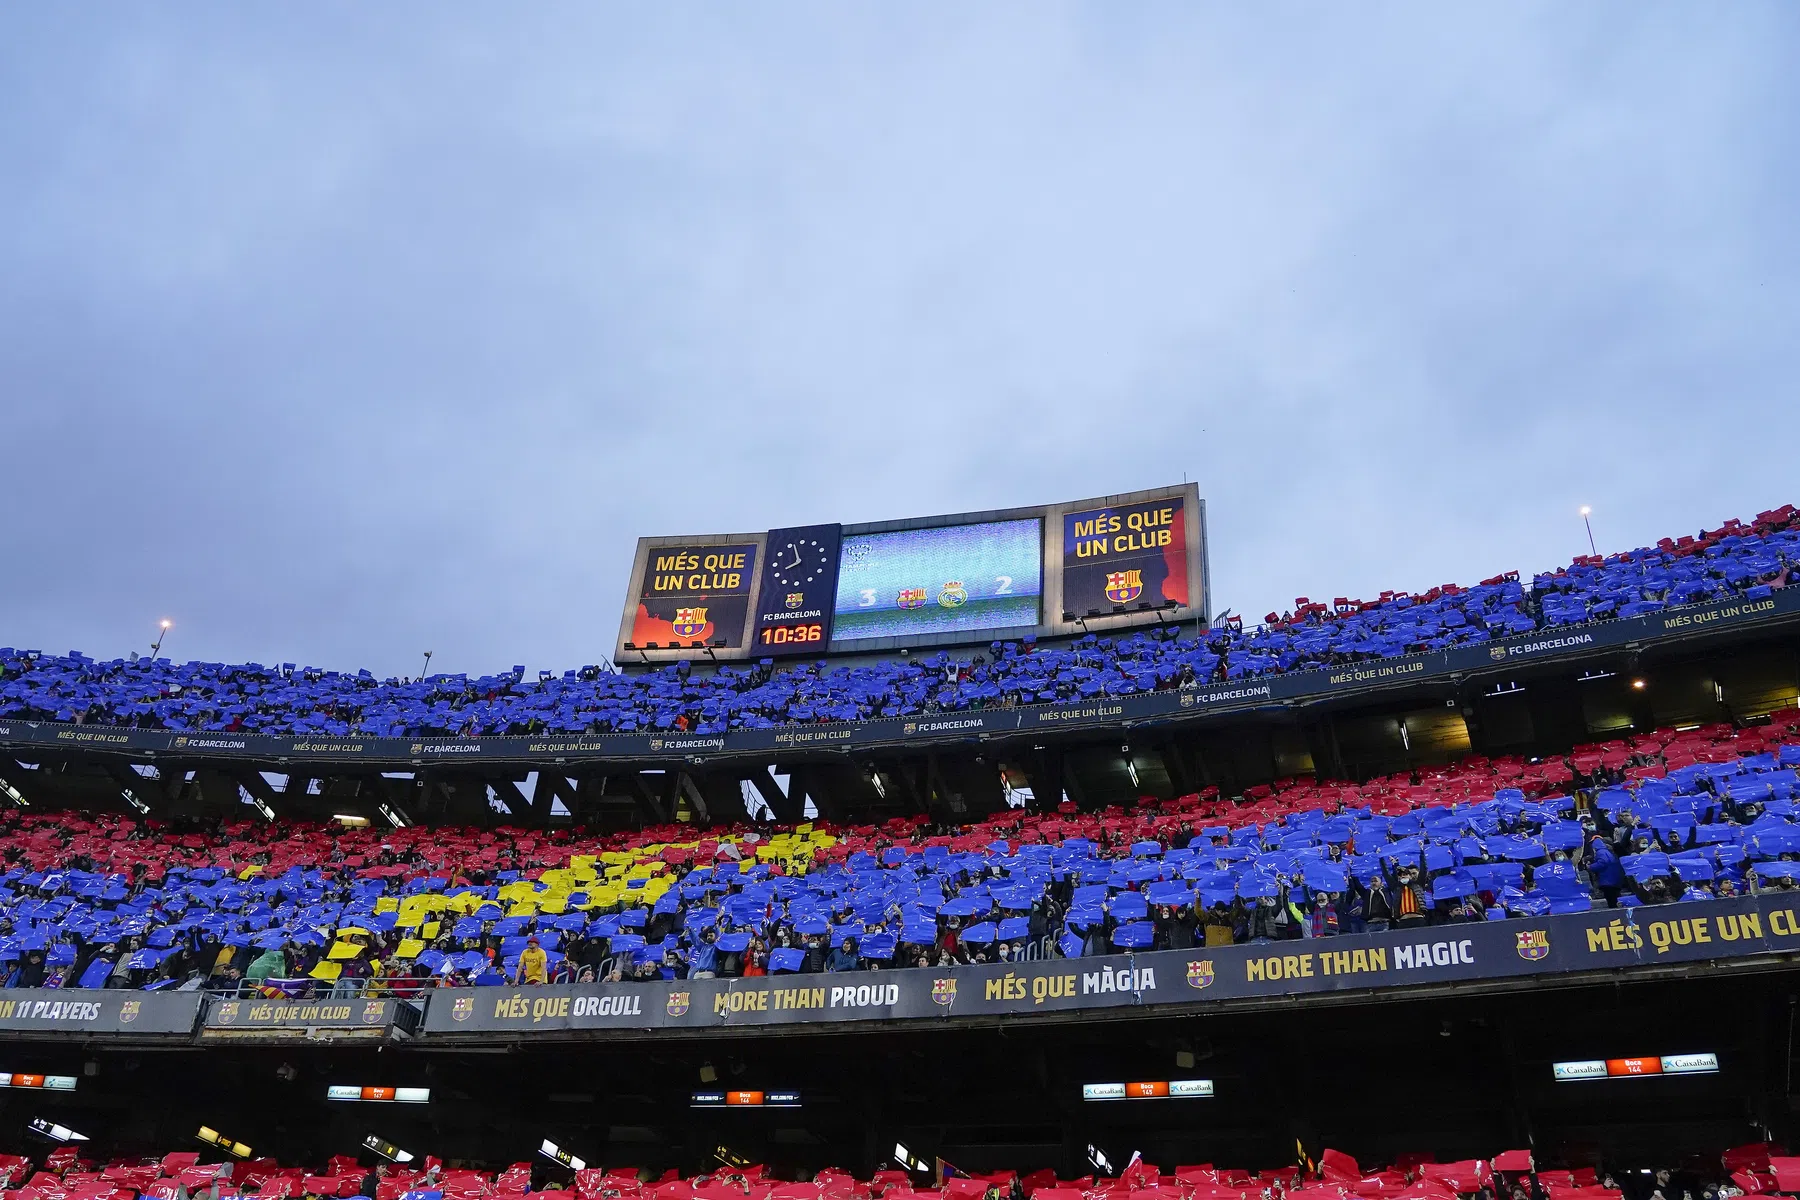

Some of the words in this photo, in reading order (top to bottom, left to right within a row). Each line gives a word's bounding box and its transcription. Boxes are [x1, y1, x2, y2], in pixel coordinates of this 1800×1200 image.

[1074, 511, 1121, 538] MÉS
[1128, 507, 1173, 532] QUE
[1076, 538, 1107, 558] UN
[1114, 529, 1172, 553] CLUB
[655, 552, 700, 571] MÉS
[704, 552, 746, 573] QUE
[654, 575, 683, 591] UN
[687, 573, 741, 590] CLUB
[995, 576, 1012, 594] 2
[859, 588, 877, 607] 3
[763, 613, 774, 621] FC
[774, 610, 821, 620] BARCELONA
[1664, 614, 1691, 629] MÉS
[1693, 610, 1720, 625] QUE
[1721, 606, 1740, 618] UN
[1742, 600, 1775, 614] CLUB
[761, 625, 822, 645] 10:36
[1508, 645, 1523, 656] FC
[1524, 633, 1592, 653] BARCELONA
[1330, 672, 1353, 684] MÉS
[1354, 669, 1376, 681] QUE
[1378, 666, 1394, 676] UN
[1395, 662, 1424, 674] CLUB
[1196, 694, 1209, 703] FC
[1209, 686, 1268, 702] BARCELONA
[1039, 709, 1060, 721] MÉS
[1061, 709, 1081, 720] QUE
[1082, 708, 1096, 717] UN
[1098, 706, 1122, 716] CLUB
[918, 723, 930, 732] FC
[930, 718, 983, 731] BARCELONA
[57, 730, 76, 740] MÉS
[76, 732, 93, 742] QUE
[93, 733, 106, 742] UN
[107, 734, 129, 743] CLUB
[187, 739, 198, 748] FC
[198, 739, 246, 749] BARCELONA
[664, 741, 675, 749] FC
[675, 738, 725, 749] BARCELONA
[775, 731, 794, 743] MÉS
[795, 732, 813, 742] QUE
[814, 732, 827, 740] UN
[828, 730, 851, 739] CLUB
[292, 741, 311, 751] MÉS
[311, 743, 328, 752] QUE
[328, 744, 341, 752] UN
[342, 744, 363, 752] CLUB
[423, 745, 434, 753] FC
[435, 744, 481, 753] BARCELONA
[529, 742, 548, 752] MÉS
[548, 743, 565, 752] QUE
[566, 743, 579, 751] UN
[1585, 918, 1644, 953] MÉS
[1649, 917, 1712, 955] QUE
[1715, 912, 1764, 941] UN
[1246, 953, 1313, 982] MORE
[1318, 947, 1388, 976] THAN
[1393, 939, 1475, 970] MAGIC
[985, 971, 1027, 1001] MÉS
[1032, 974, 1076, 1004] QUE
[1081, 967, 1156, 995] MÀGIA
[713, 990, 768, 1013] MORE
[773, 987, 826, 1010] THAN
[830, 984, 900, 1008] PROUD
[16, 1000, 32, 1019] 11
[31, 1001, 101, 1021] PLAYERS
[249, 1004, 271, 1021] MÉS
[273, 1006, 300, 1023] QUE
[300, 1006, 319, 1020] UN
[320, 1005, 351, 1020] CLUB
[494, 994, 531, 1018] MÉS
[532, 997, 571, 1023] QUE
[573, 995, 642, 1017] ORGULL
[1566, 1064, 1606, 1074] CaixaBank
[1675, 1058, 1716, 1068] CaixaBank
[1179, 1084, 1212, 1092] CaixaBank
